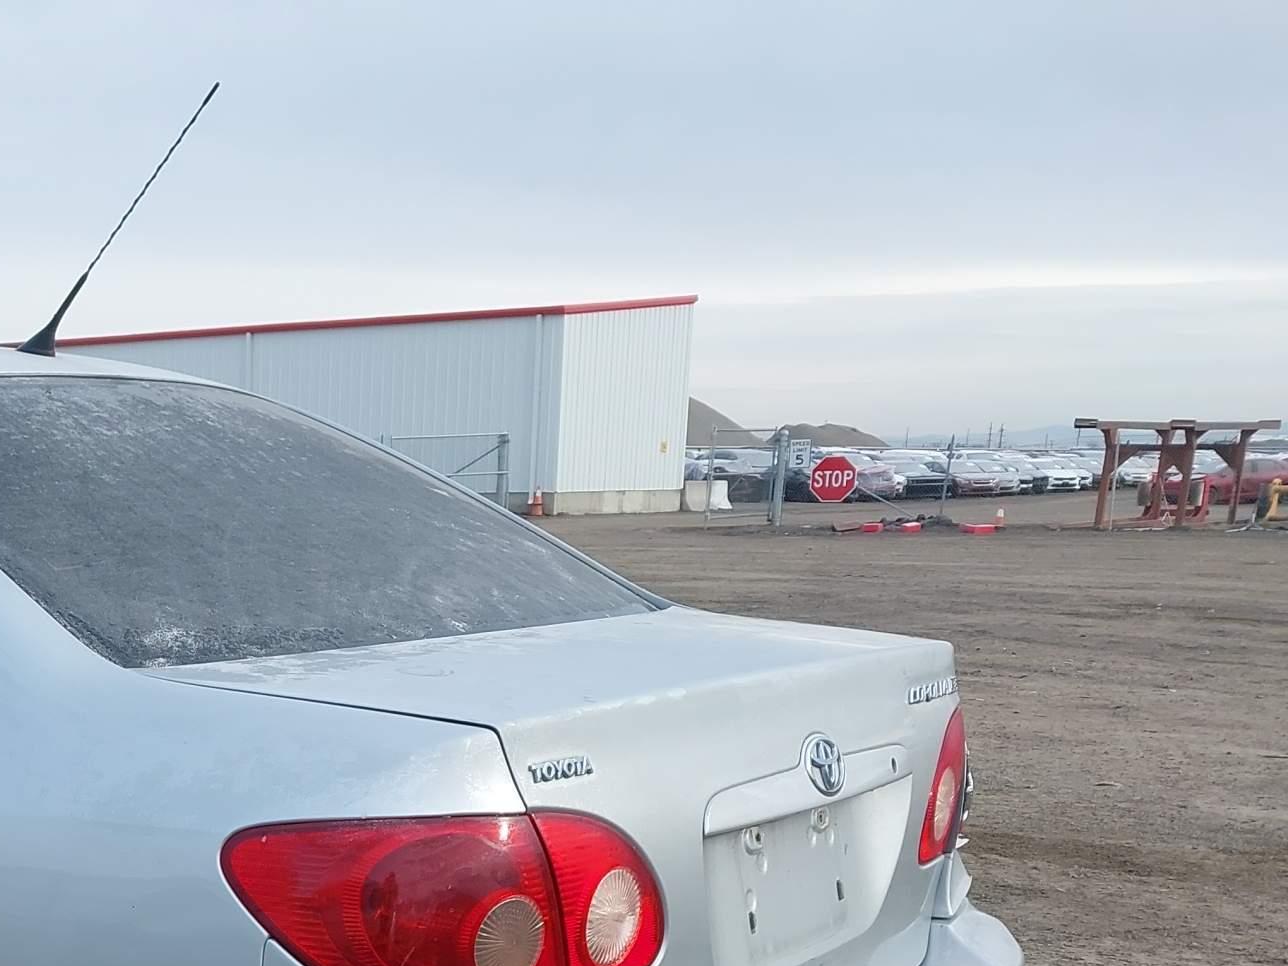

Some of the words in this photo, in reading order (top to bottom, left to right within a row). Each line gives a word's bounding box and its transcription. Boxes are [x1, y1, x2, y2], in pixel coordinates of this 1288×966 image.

[795, 454, 804, 465] 5
[813, 470, 853, 488] STOP
[528, 753, 594, 783] TOYOTA
